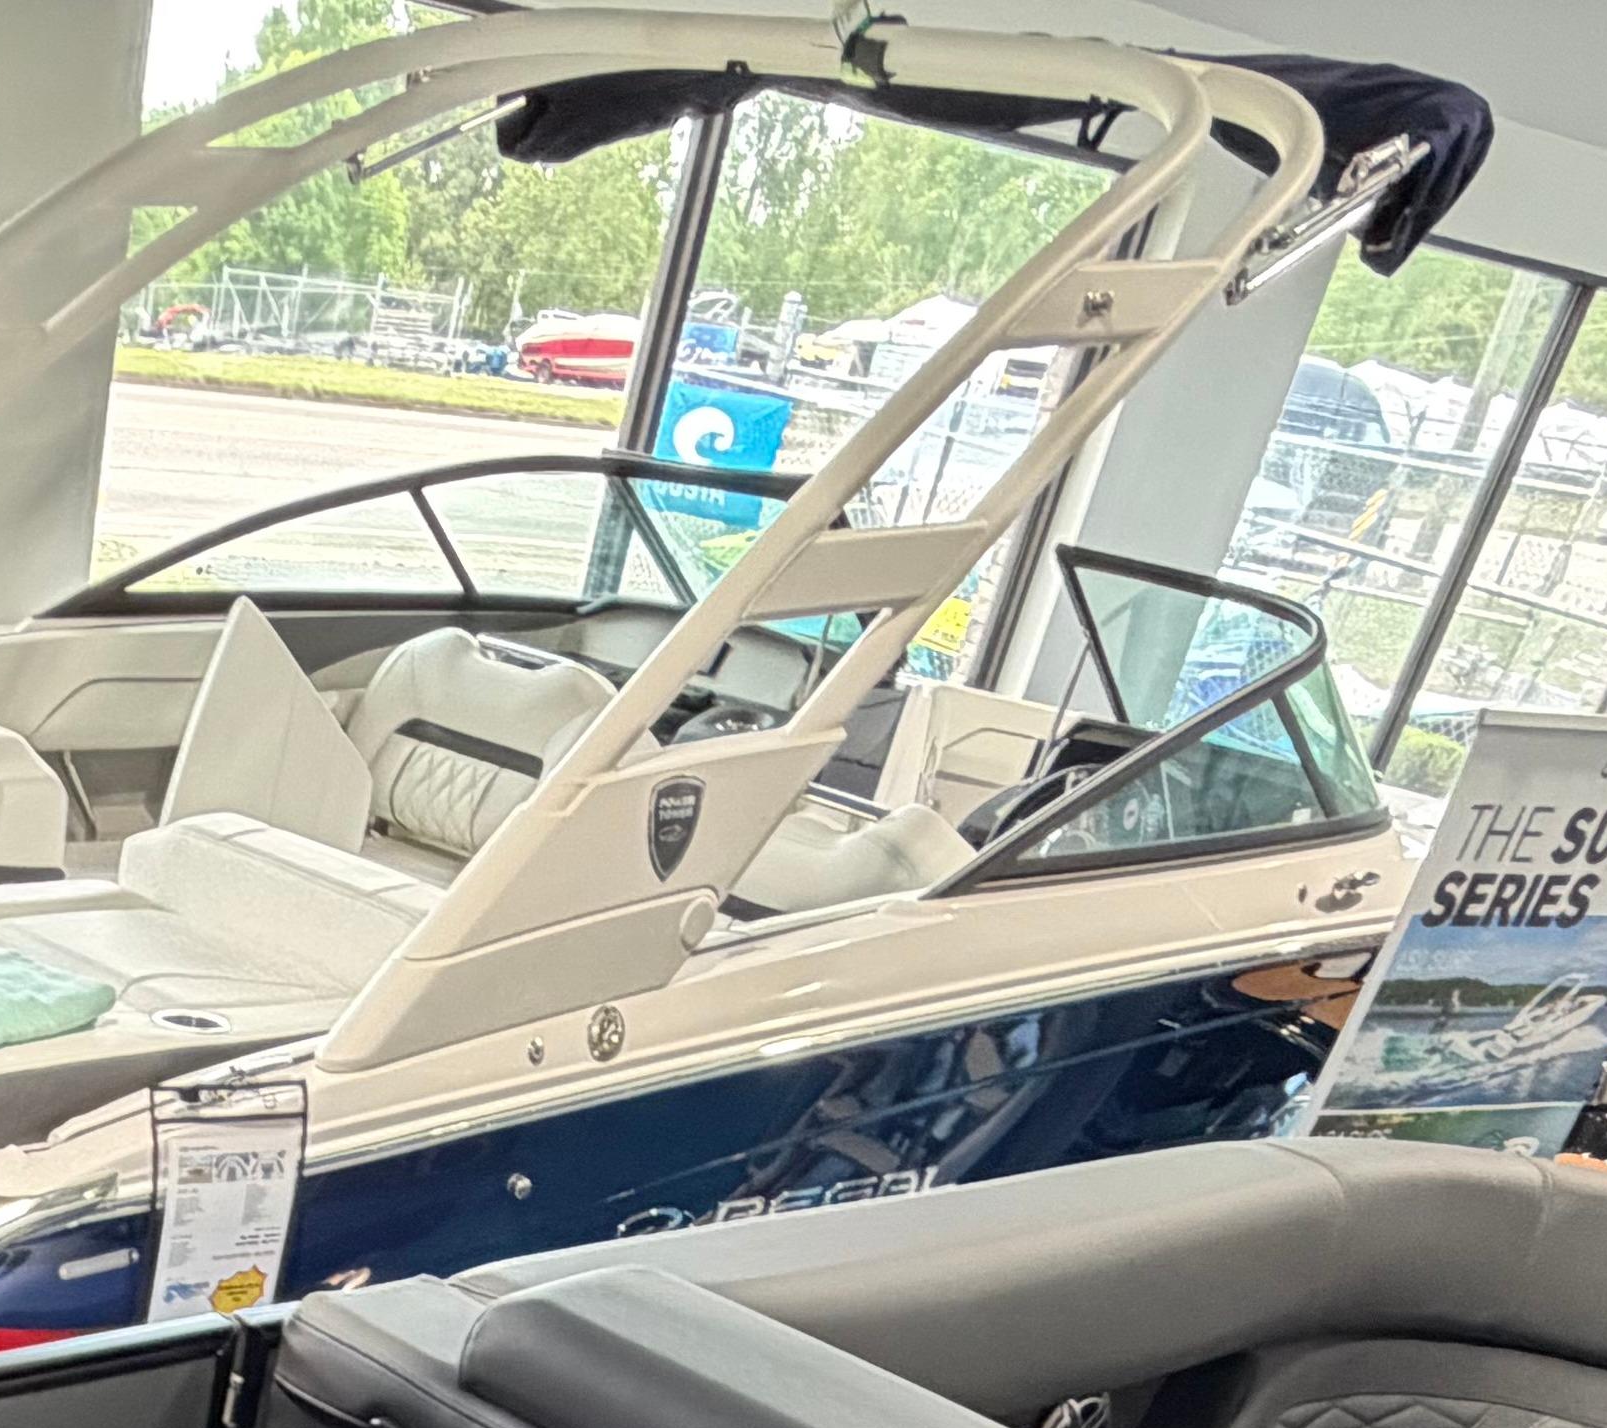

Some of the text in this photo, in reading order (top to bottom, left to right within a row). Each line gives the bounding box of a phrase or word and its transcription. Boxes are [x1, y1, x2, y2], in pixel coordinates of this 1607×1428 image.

[1455, 804, 1556, 862] THE
[1420, 871, 1601, 928] SERIES
[716, 1166, 958, 1222] REGAL
